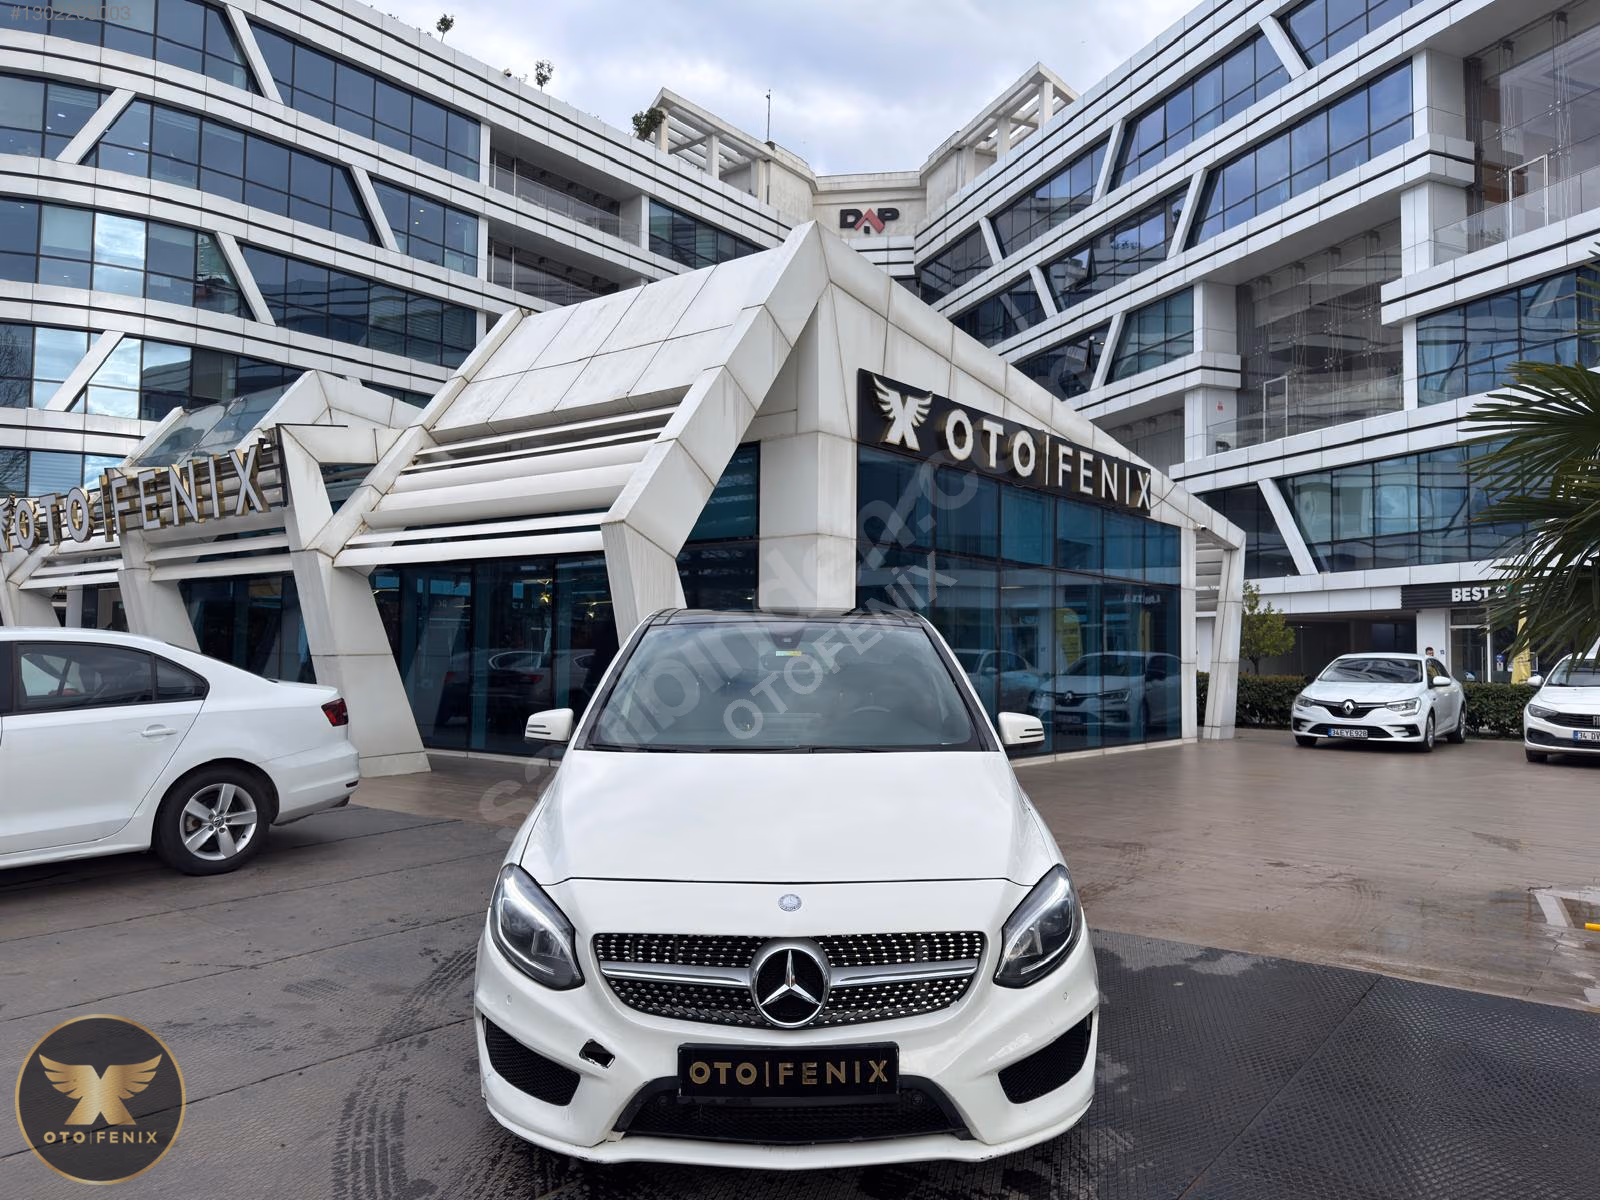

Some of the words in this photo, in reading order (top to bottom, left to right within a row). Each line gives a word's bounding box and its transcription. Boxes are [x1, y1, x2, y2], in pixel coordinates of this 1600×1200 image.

[945, 408, 1036, 477] OTO
[1057, 443, 1151, 510] FENIX
[15, 487, 90, 550] OTO
[110, 444, 266, 537] FENIX
[1451, 586, 1491, 602] BEST
[689, 1061, 757, 1086] OTO
[778, 1060, 888, 1085] FENIX
